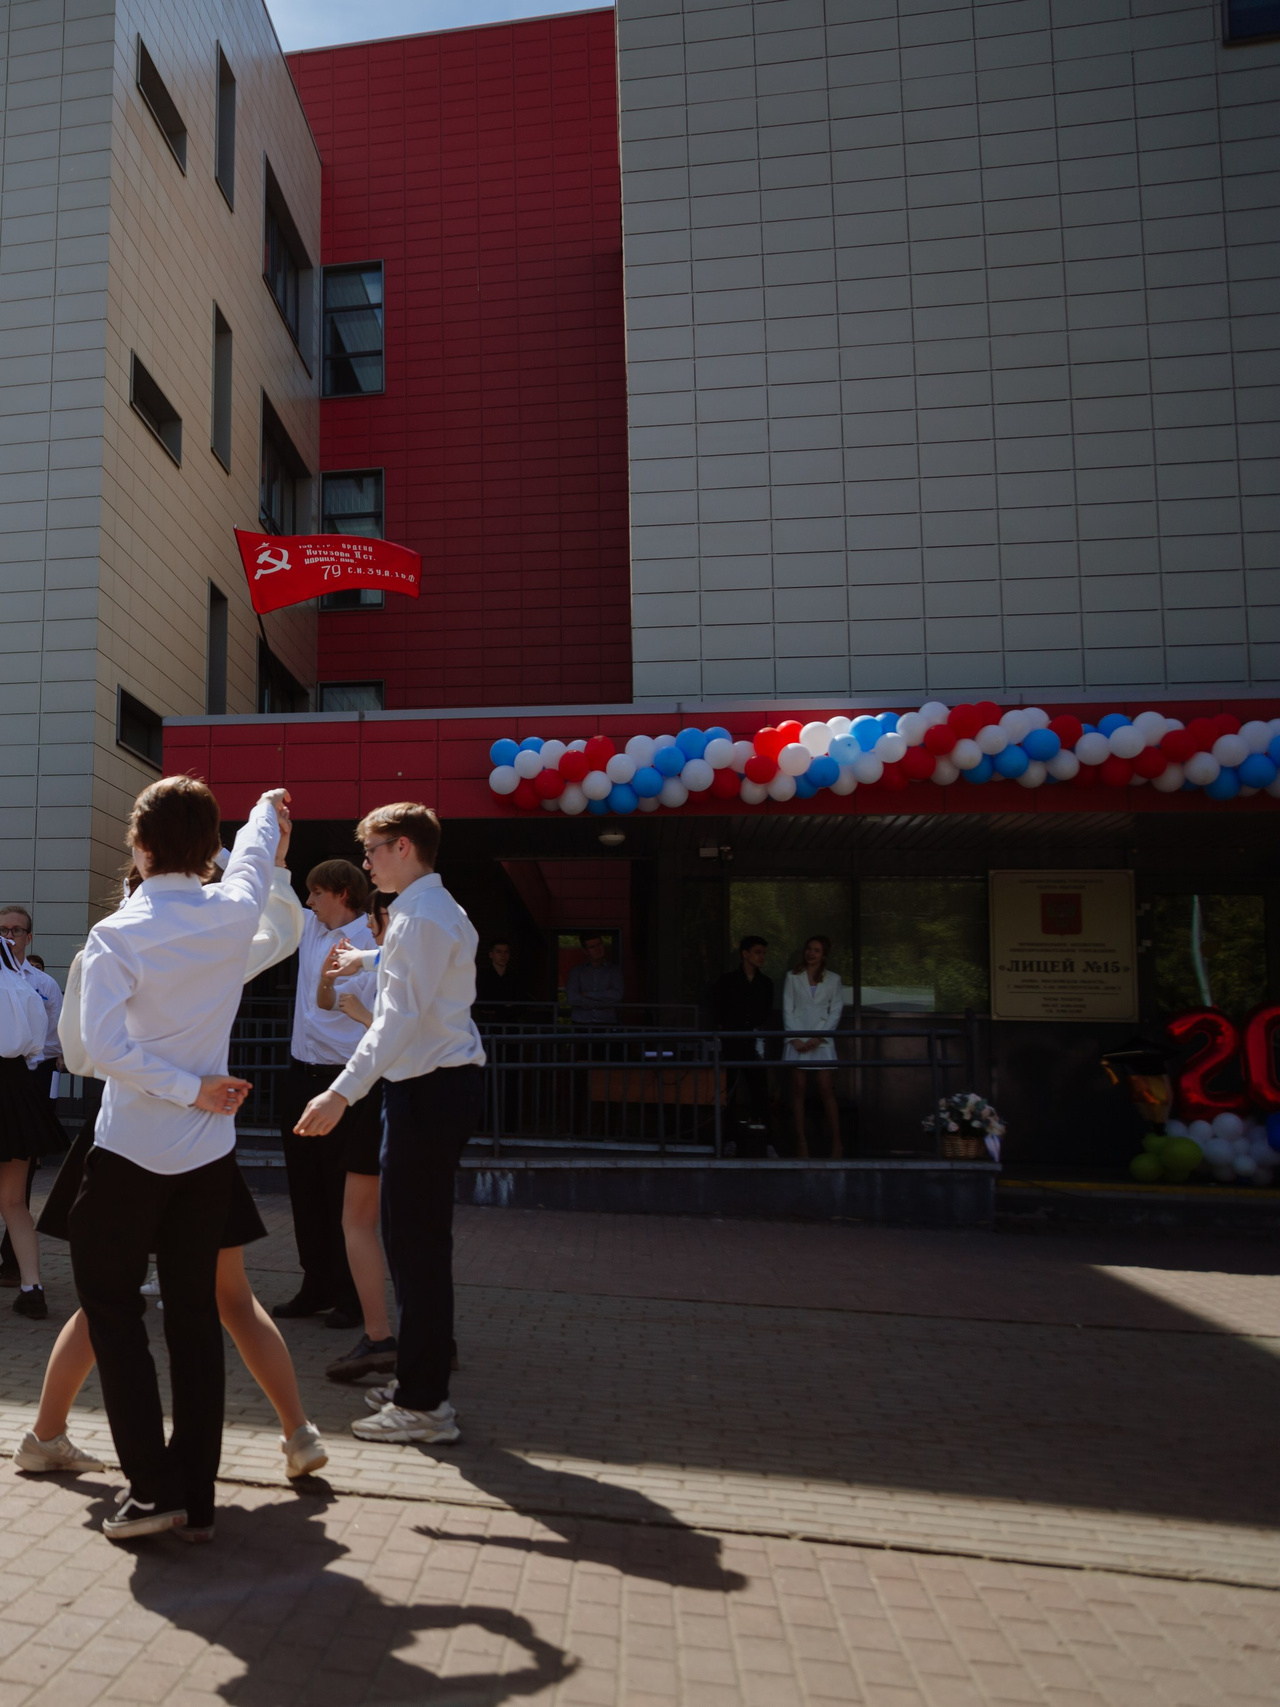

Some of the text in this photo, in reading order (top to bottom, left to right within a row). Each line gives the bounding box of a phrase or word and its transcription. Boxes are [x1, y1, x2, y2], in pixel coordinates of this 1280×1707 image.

[321, 564, 342, 581] 79
[998, 957, 1130, 974] «ЛИЦЕЙ №15»
